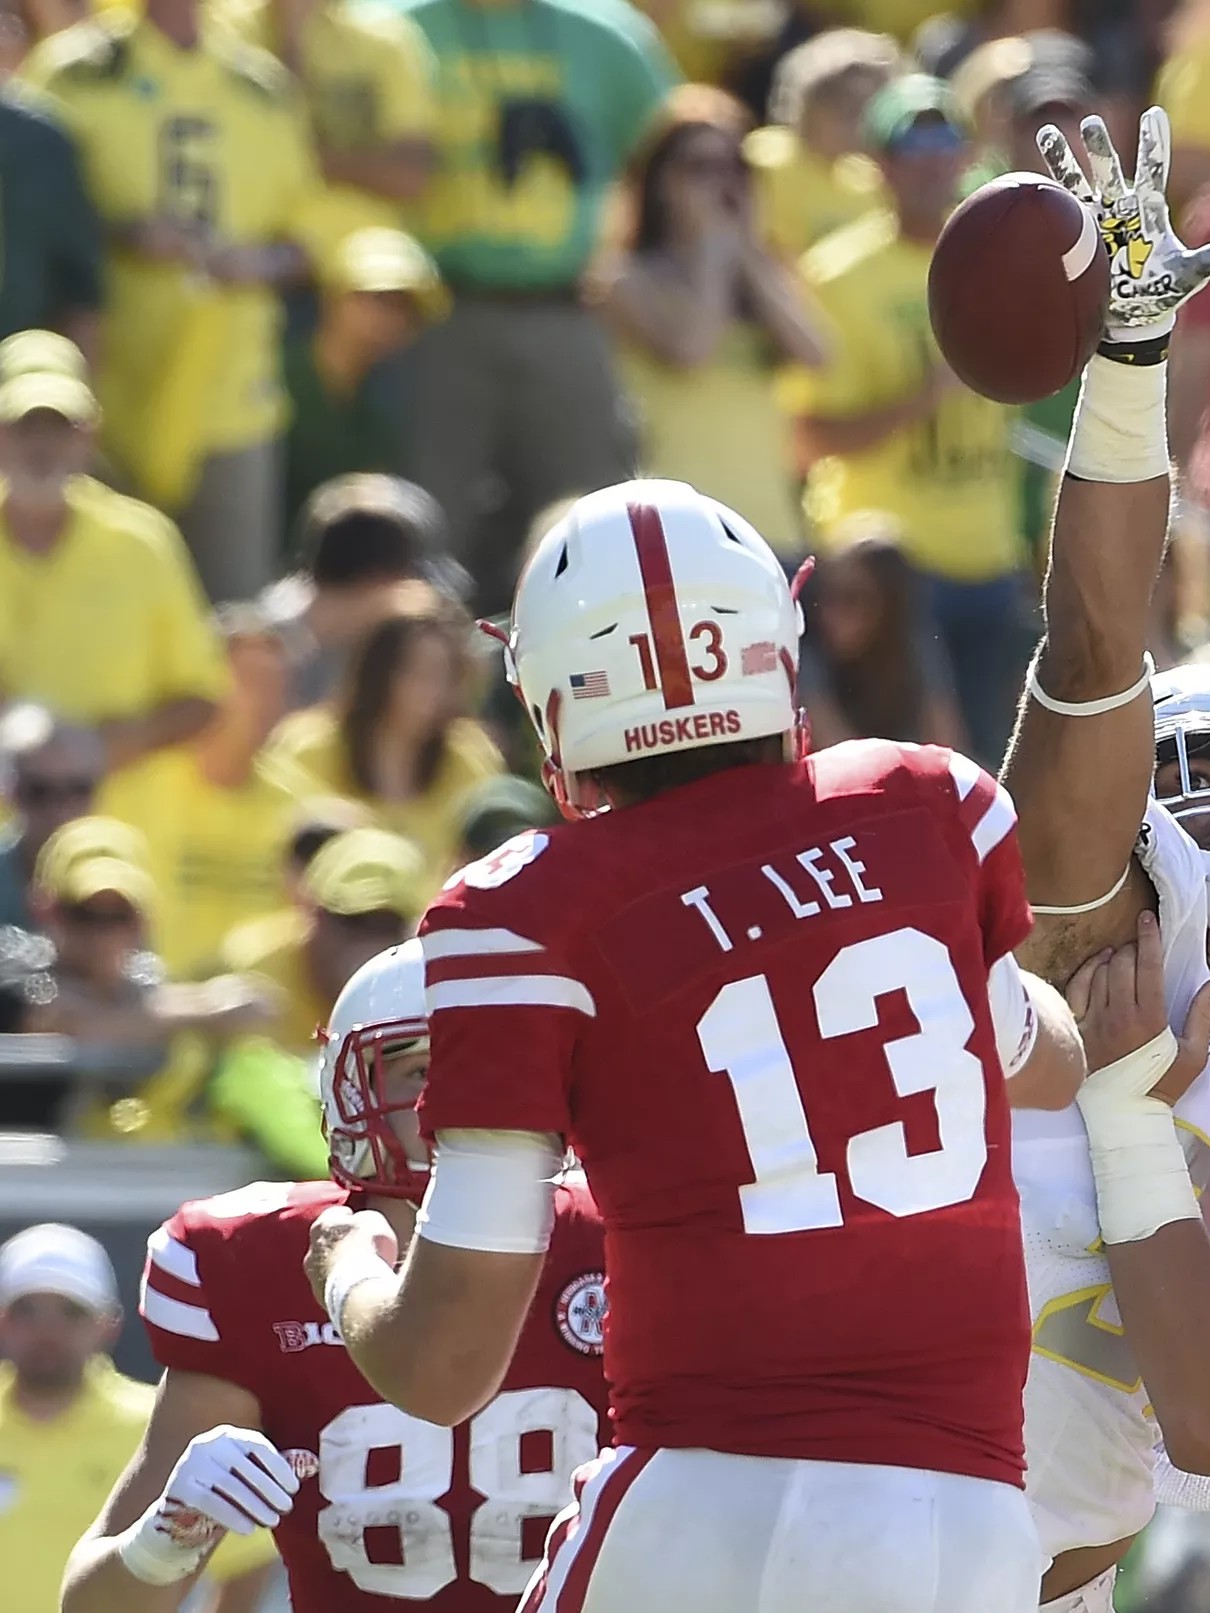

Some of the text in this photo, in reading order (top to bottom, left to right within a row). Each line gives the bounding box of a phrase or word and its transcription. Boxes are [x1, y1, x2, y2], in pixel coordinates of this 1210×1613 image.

[629, 620, 728, 691] 13
[624, 710, 742, 752] HUSKERS
[680, 836, 883, 952] T. LEE
[697, 927, 987, 1235] 13
[318, 1386, 599, 1600] 88
